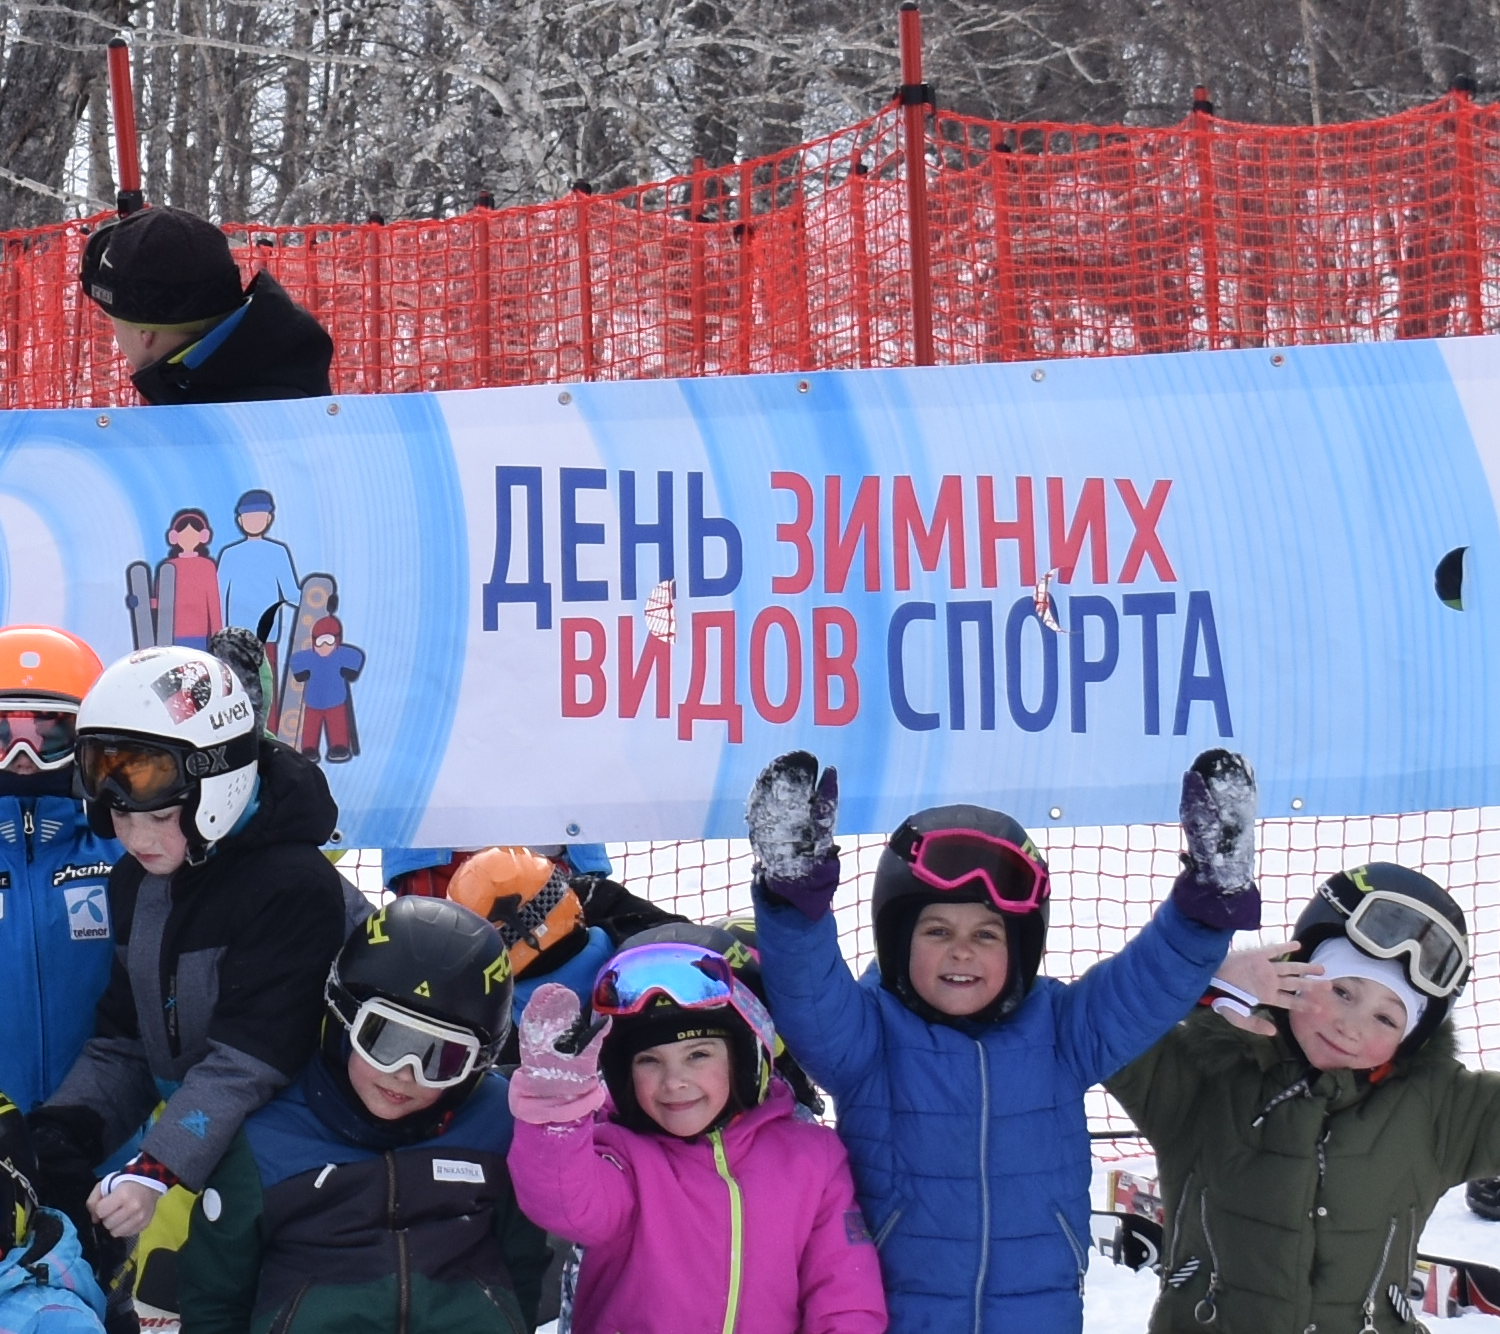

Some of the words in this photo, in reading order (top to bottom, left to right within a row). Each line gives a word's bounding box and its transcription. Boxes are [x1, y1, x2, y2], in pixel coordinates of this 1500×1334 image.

[482, 464, 744, 633] ДЕНЬ
[769, 470, 1178, 595] ЗИМНИХ
[559, 604, 861, 744] ВИДОВ
[886, 590, 1235, 738] СПОРТА
[208, 699, 250, 731] uvex
[53, 861, 114, 887] phenix
[72, 926, 109, 939] telenor
[676, 1028, 703, 1040] DRY
